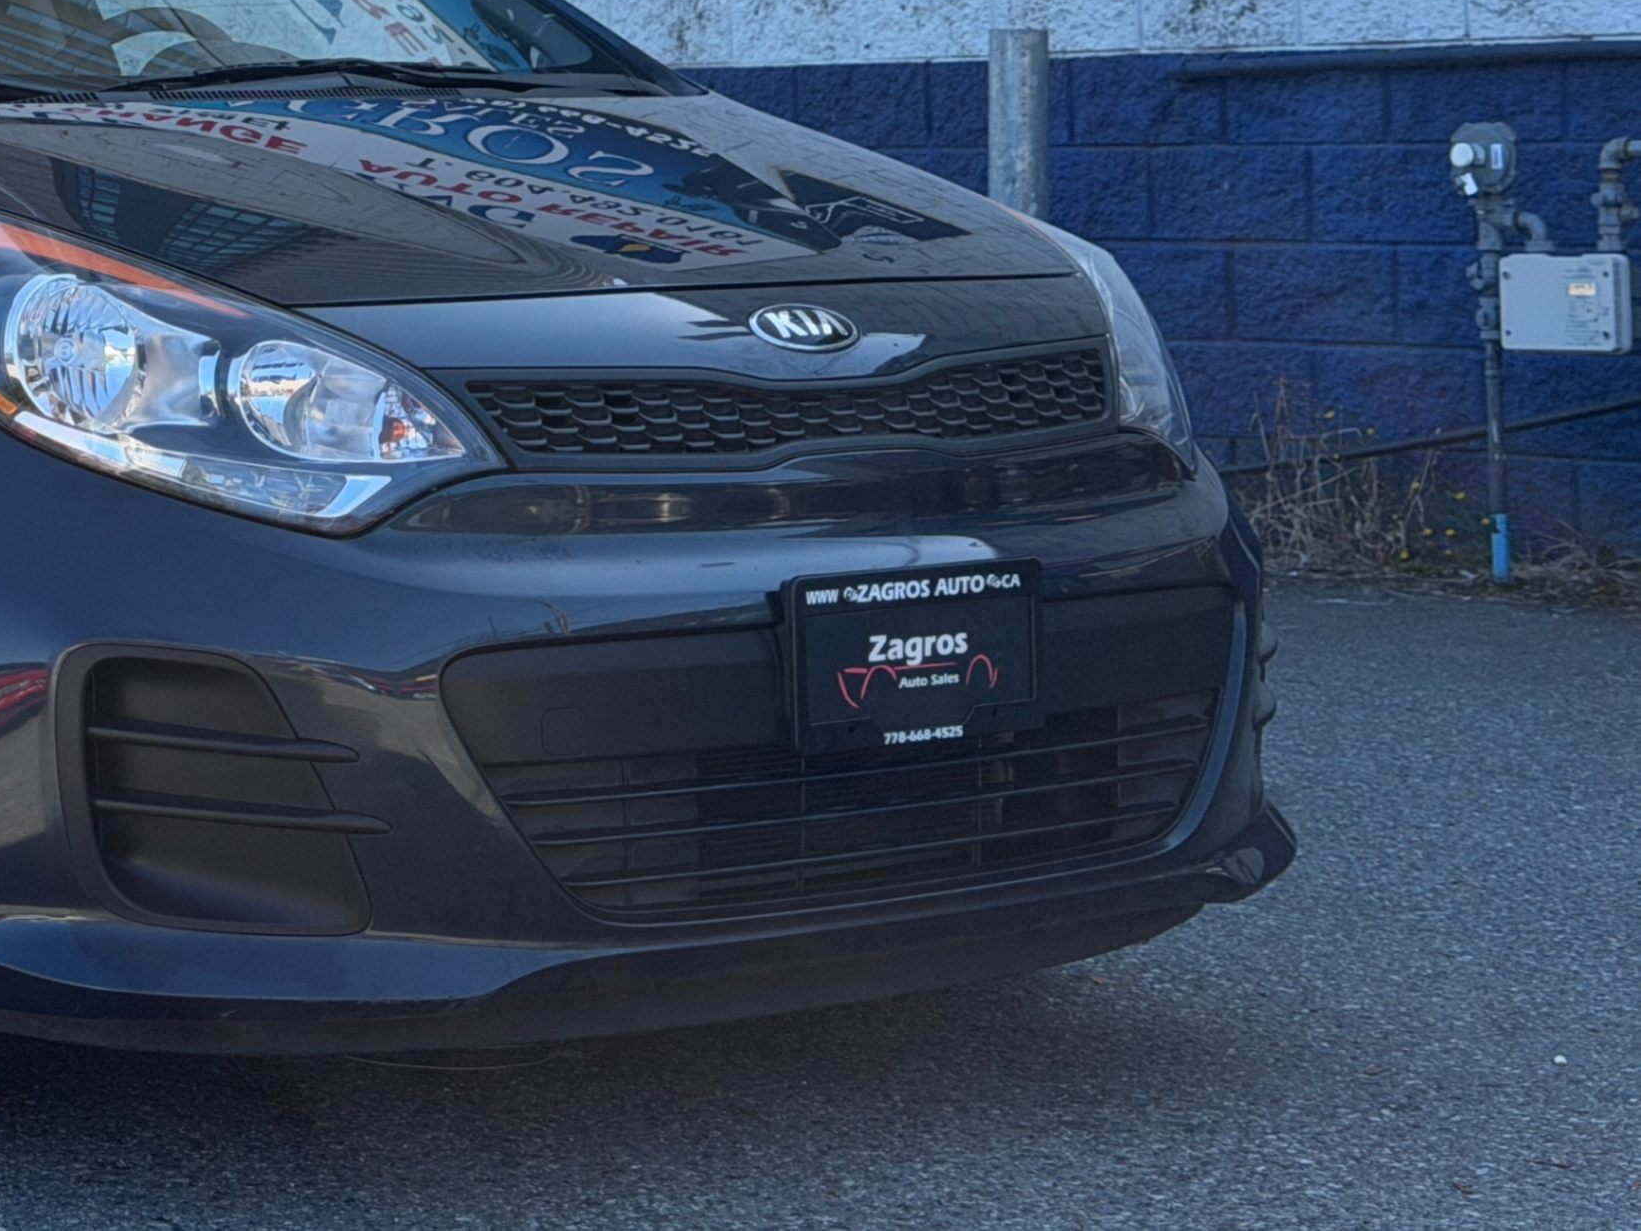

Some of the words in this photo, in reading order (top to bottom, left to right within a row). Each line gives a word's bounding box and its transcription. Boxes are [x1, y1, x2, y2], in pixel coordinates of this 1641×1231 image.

[763, 308, 850, 339] KIA
[805, 588, 839, 606] WWW
[857, 579, 931, 603] ZAGROS
[933, 575, 985, 597] AUTO
[1001, 574, 1021, 589] CA
[867, 632, 969, 666] Zagros
[898, 677, 928, 689] Auto
[931, 673, 960, 685] Sales
[883, 725, 964, 746] 778-668-4525
